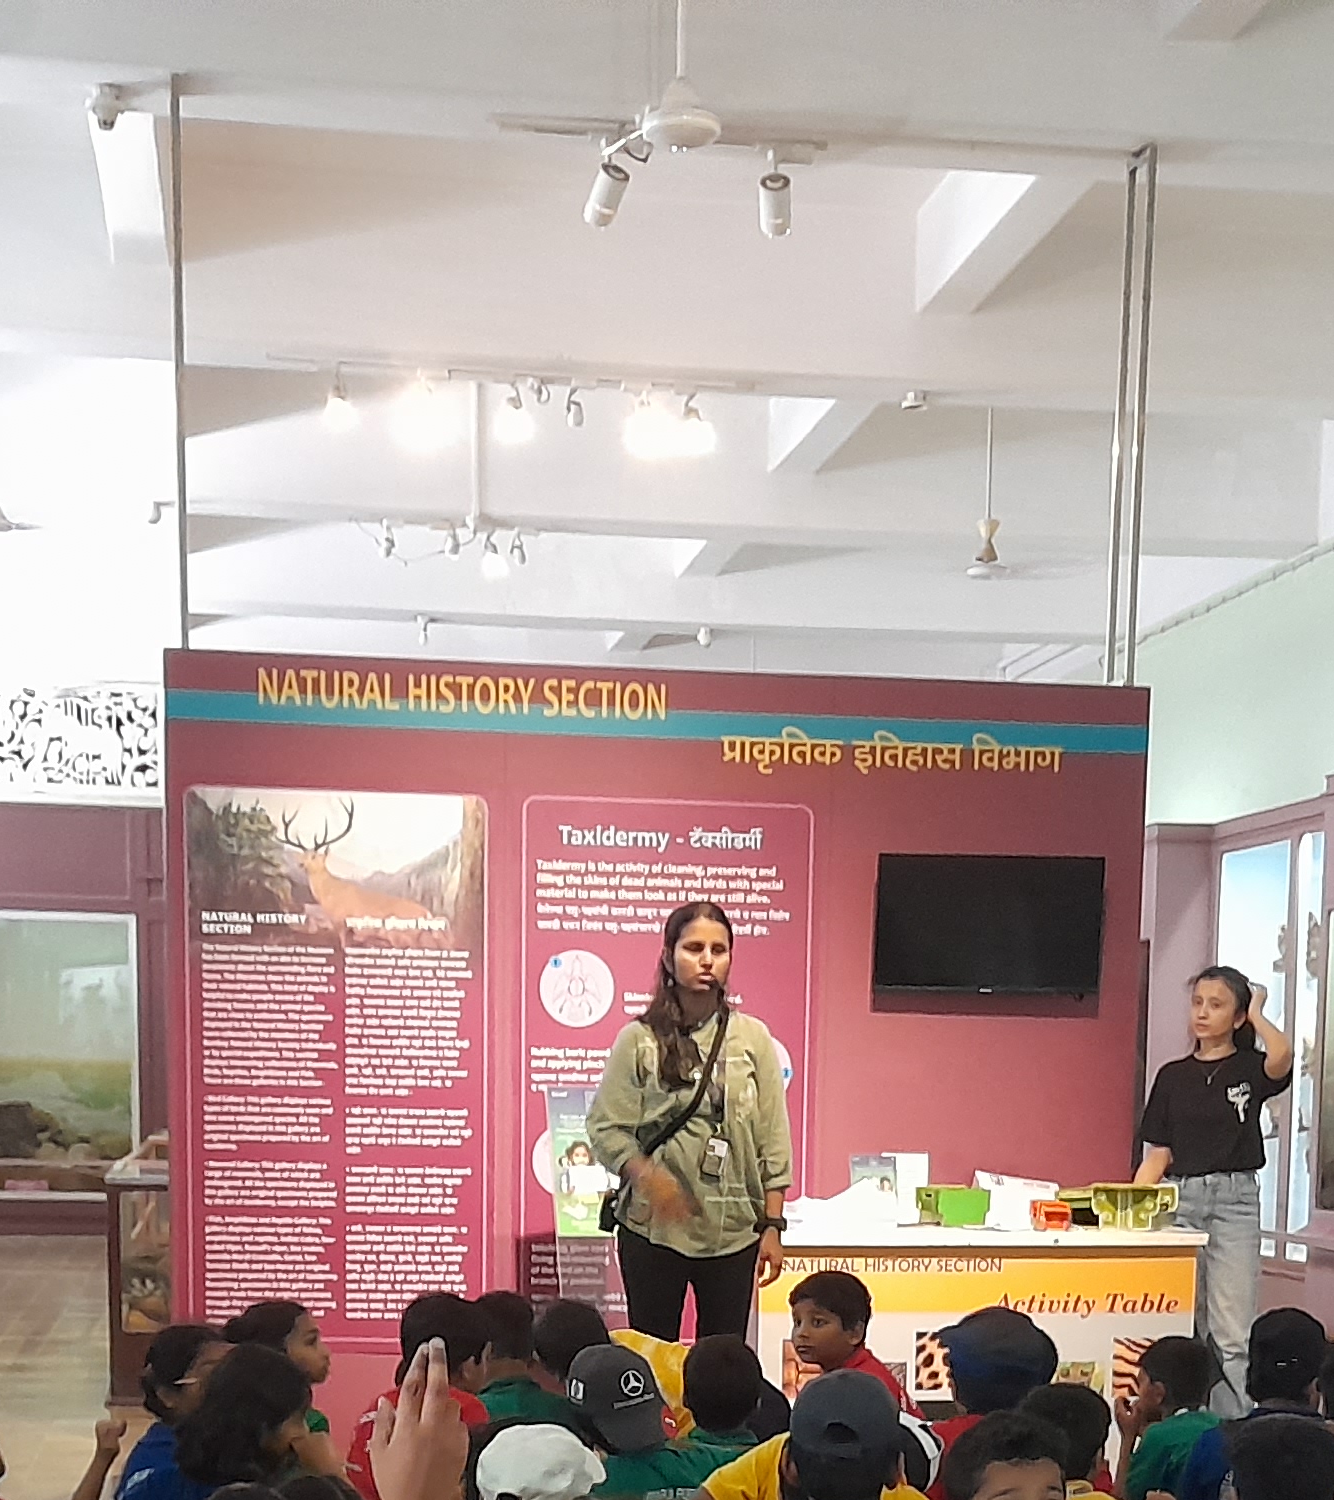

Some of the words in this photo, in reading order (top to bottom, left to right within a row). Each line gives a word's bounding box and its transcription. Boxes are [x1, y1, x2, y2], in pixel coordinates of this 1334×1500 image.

[257, 666, 400, 711] NATURAL
[407, 672, 537, 717] HISTORY
[543, 679, 668, 721] SECTION
[720, 726, 844, 775] प्राकृतिक
[851, 729, 964, 775] इतिहास
[971, 732, 1062, 774] विभाग
[558, 824, 670, 852] Taxidermy
[536, 858, 587, 874] Taxidermy
[597, 860, 614, 872] the
[615, 862, 650, 875] activity
[651, 862, 663, 874] of
[759, 865, 777, 877] and
[565, 874, 582, 885] the
[608, 874, 621, 886] of
[577, 888, 589, 899] to
[201, 910, 255, 924] NATURAL
[256, 912, 307, 925] HISTORY
[201, 923, 252, 935] SECTION
[782, 1257, 860, 1273] NATURAL
[864, 1257, 933, 1273] HISTORY
[936, 1257, 1002, 1274] SECTION
[998, 1292, 1096, 1319] Activity
[1105, 1292, 1179, 1314] Table
